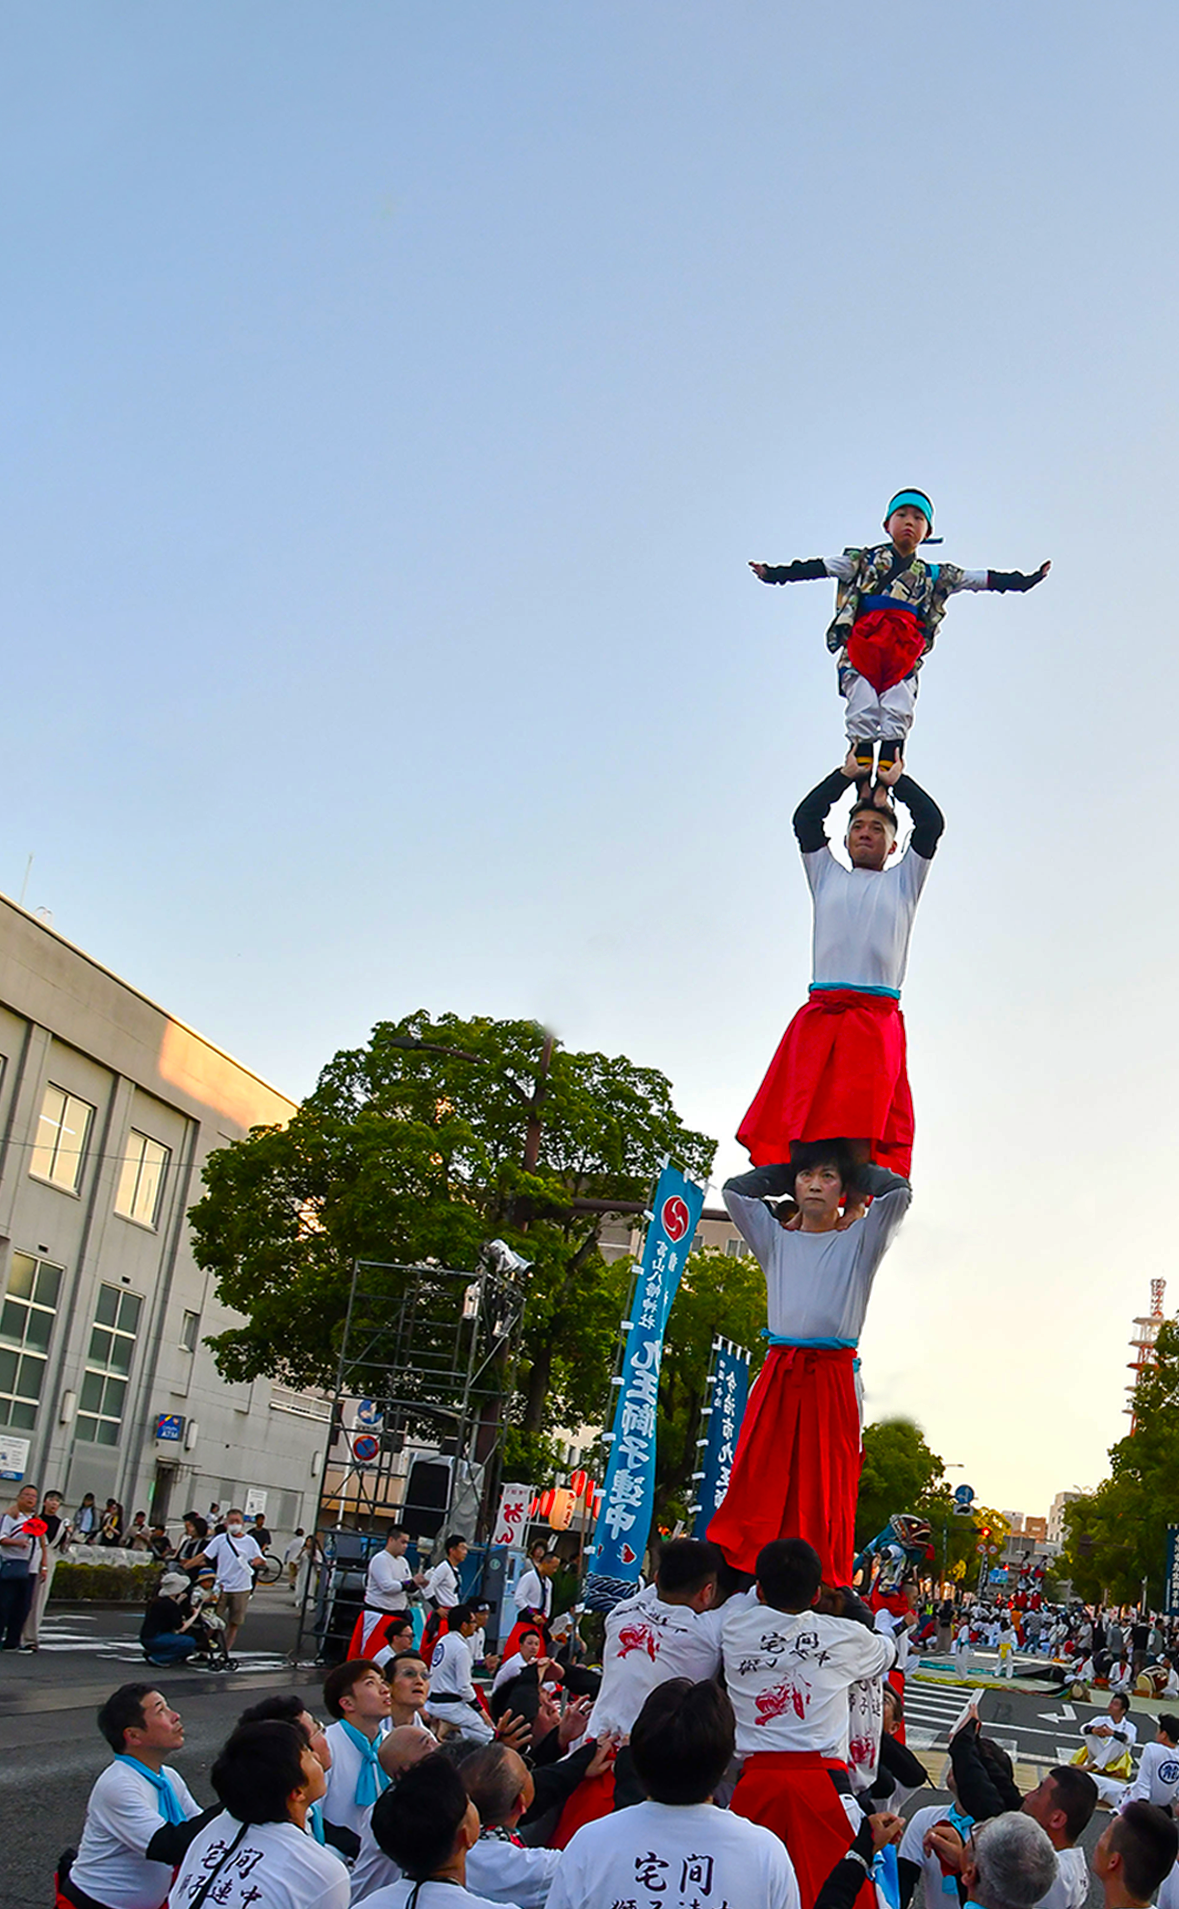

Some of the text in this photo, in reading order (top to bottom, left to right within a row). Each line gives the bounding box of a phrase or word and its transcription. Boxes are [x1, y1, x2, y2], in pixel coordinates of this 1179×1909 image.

[760, 1632, 819, 1655] 宅間
[201, 1840, 264, 1879] 宅間
[635, 1851, 714, 1896] 宅間
